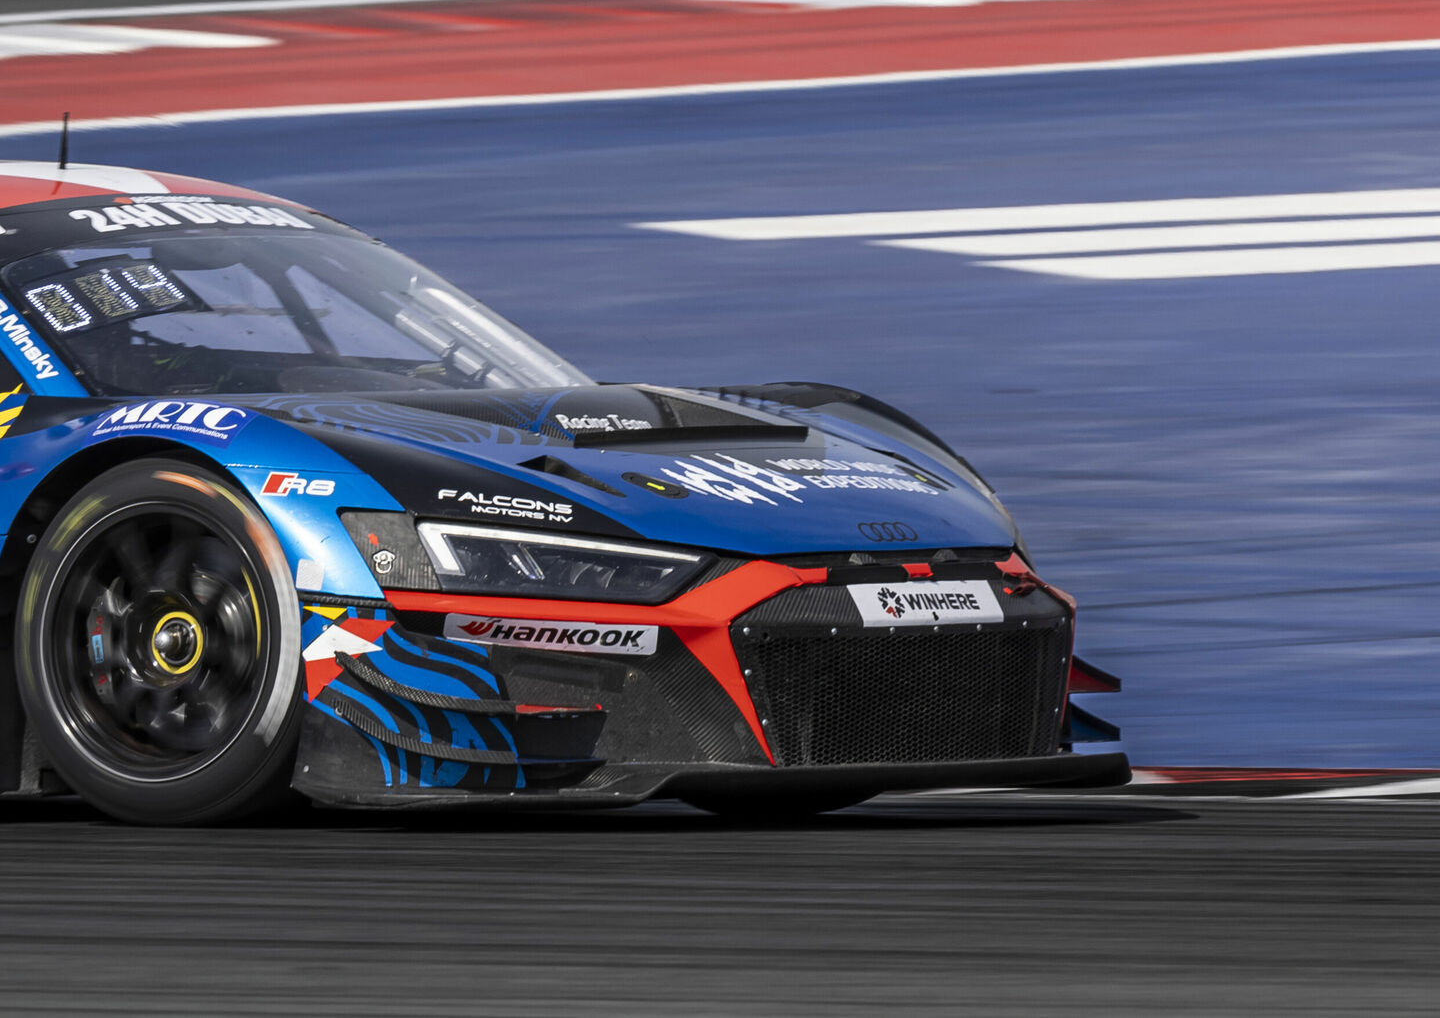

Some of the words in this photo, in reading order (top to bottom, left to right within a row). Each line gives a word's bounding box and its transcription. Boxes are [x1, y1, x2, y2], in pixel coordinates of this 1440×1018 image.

[68, 204, 183, 232] 24H
[162, 202, 316, 229] DUBAI
[97, 401, 247, 431] MRTC
[555, 414, 615, 432] Racing
[606, 414, 653, 430] Team
[172, 423, 228, 440] Communications
[765, 459, 851, 471] WORLD
[272, 474, 337, 496] R8
[438, 489, 573, 515] FALCONS
[471, 505, 545, 519] MOTORS
[548, 514, 573, 523] NV
[902, 593, 981, 611] WINHERE
